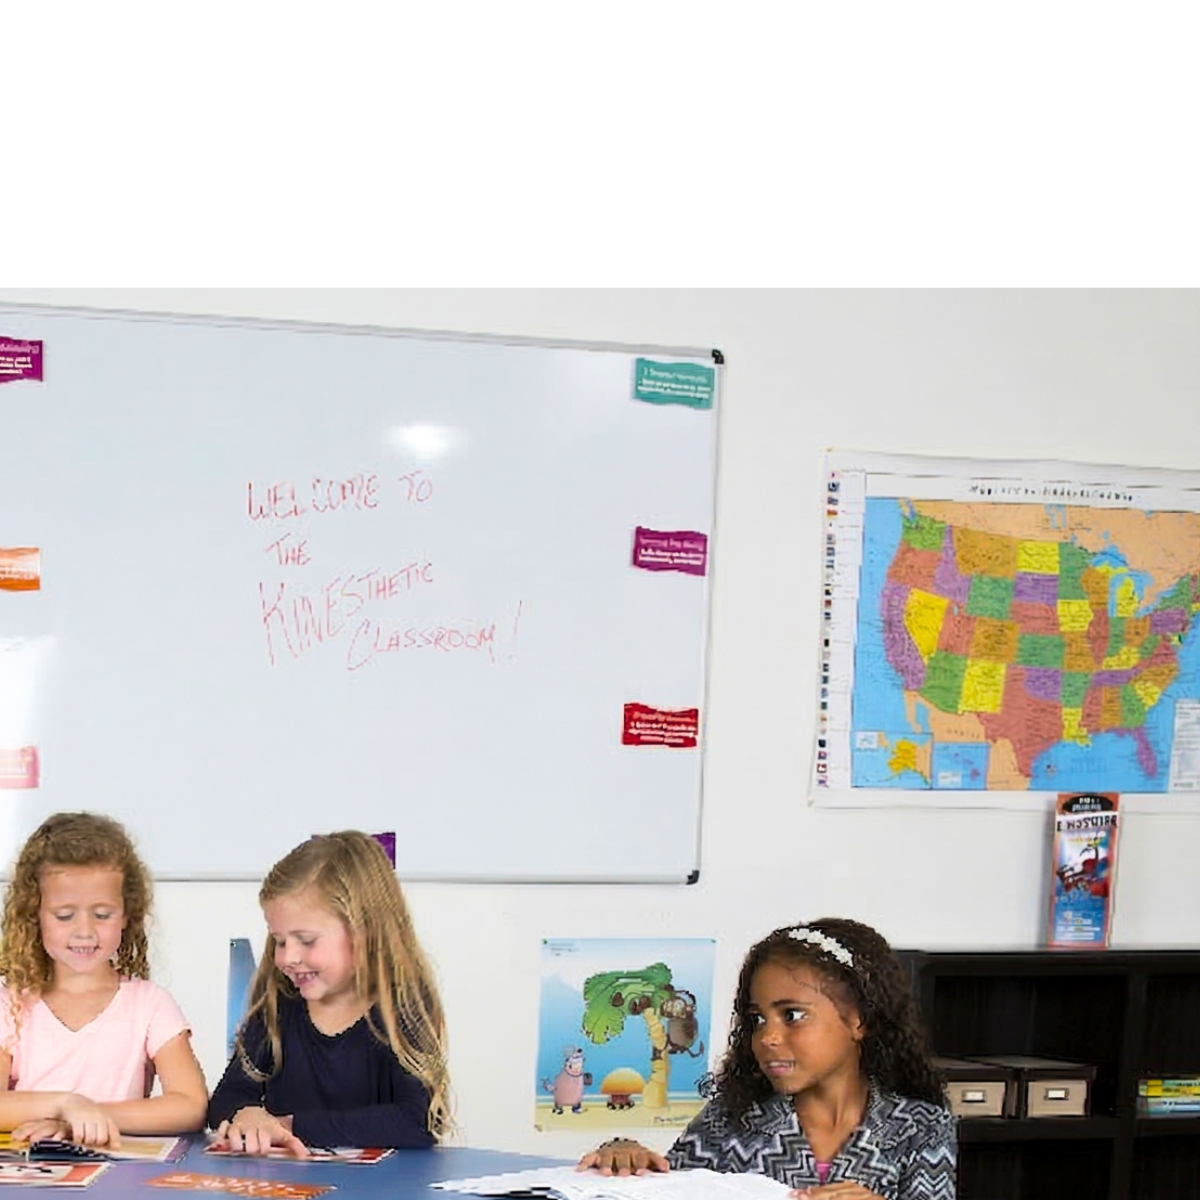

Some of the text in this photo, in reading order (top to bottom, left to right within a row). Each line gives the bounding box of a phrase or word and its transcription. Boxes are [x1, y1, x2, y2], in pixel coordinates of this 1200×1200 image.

[248, 471, 434, 521] WELCOME TO
[265, 532, 311, 566] THE
[259, 563, 434, 667] KINESTHETIC
